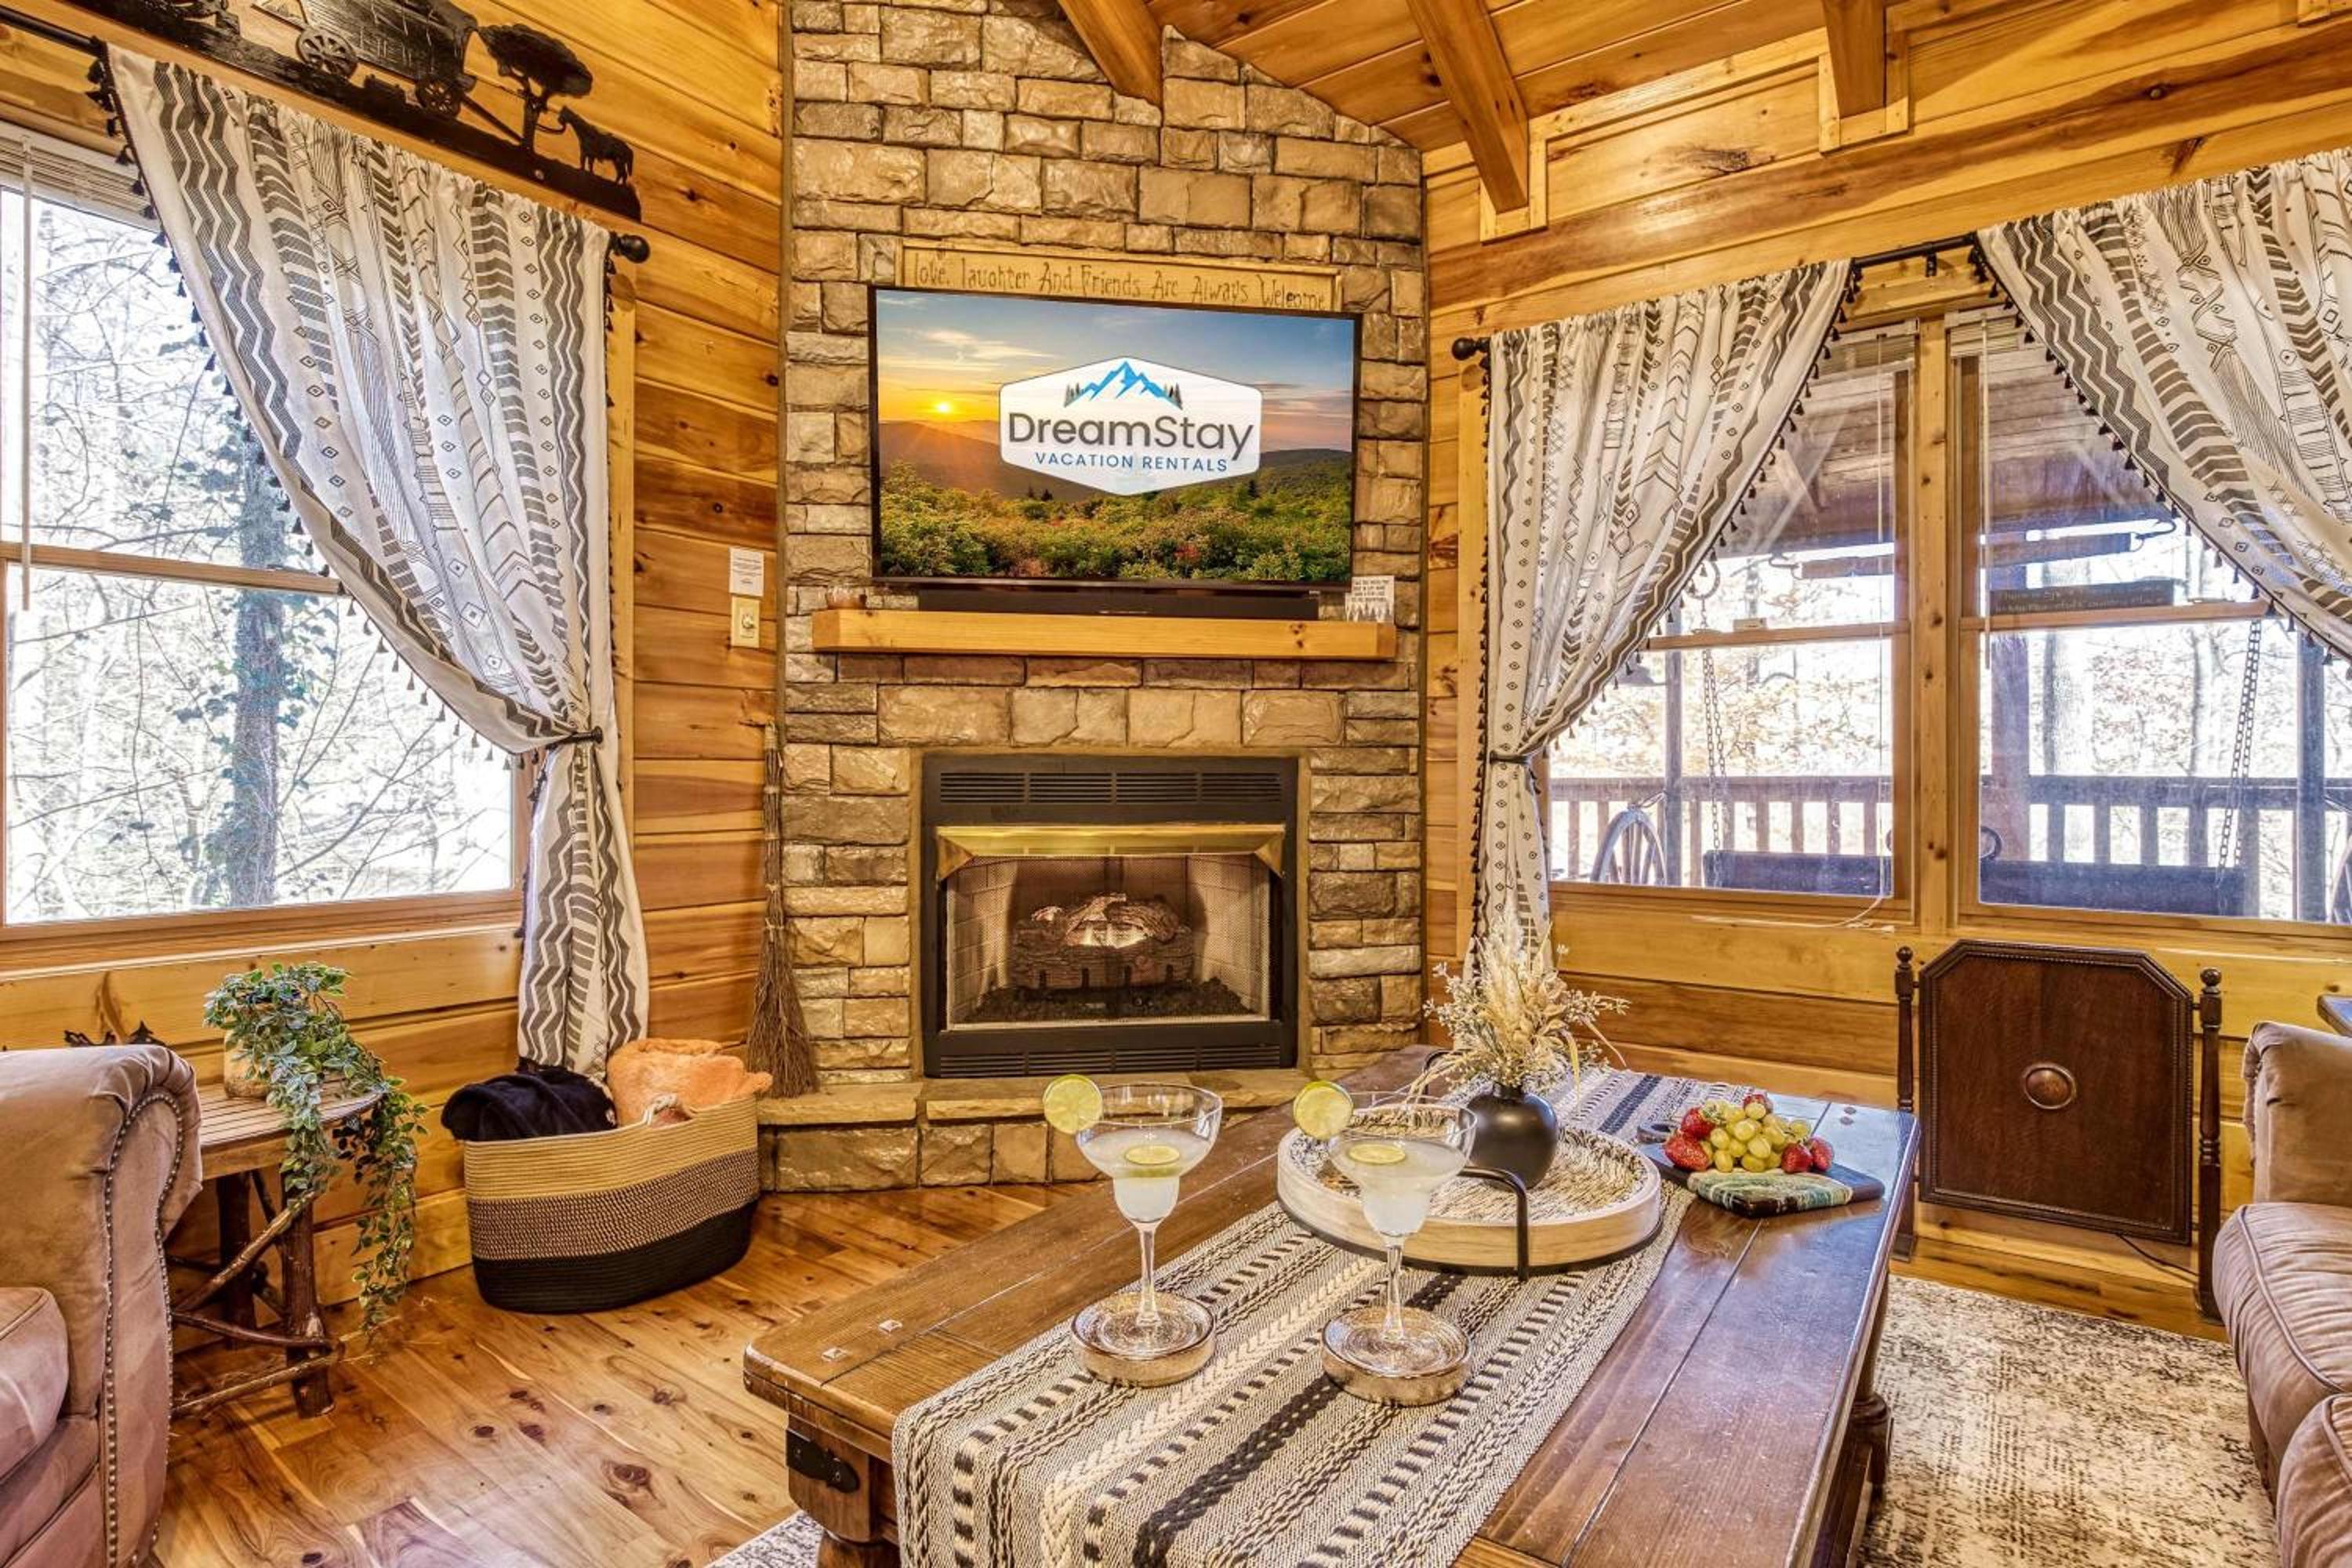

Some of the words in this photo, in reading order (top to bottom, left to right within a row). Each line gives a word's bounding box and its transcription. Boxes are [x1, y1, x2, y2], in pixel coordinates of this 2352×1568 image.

[1037, 262, 1073, 294] And
[1080, 263, 1142, 297] Friends
[1151, 269, 1179, 299] Are
[1190, 275, 1249, 305] Always
[1008, 412, 1254, 461] DreamStay
[1035, 452, 1134, 469] VACATION
[1142, 456, 1228, 472] RENTALS
